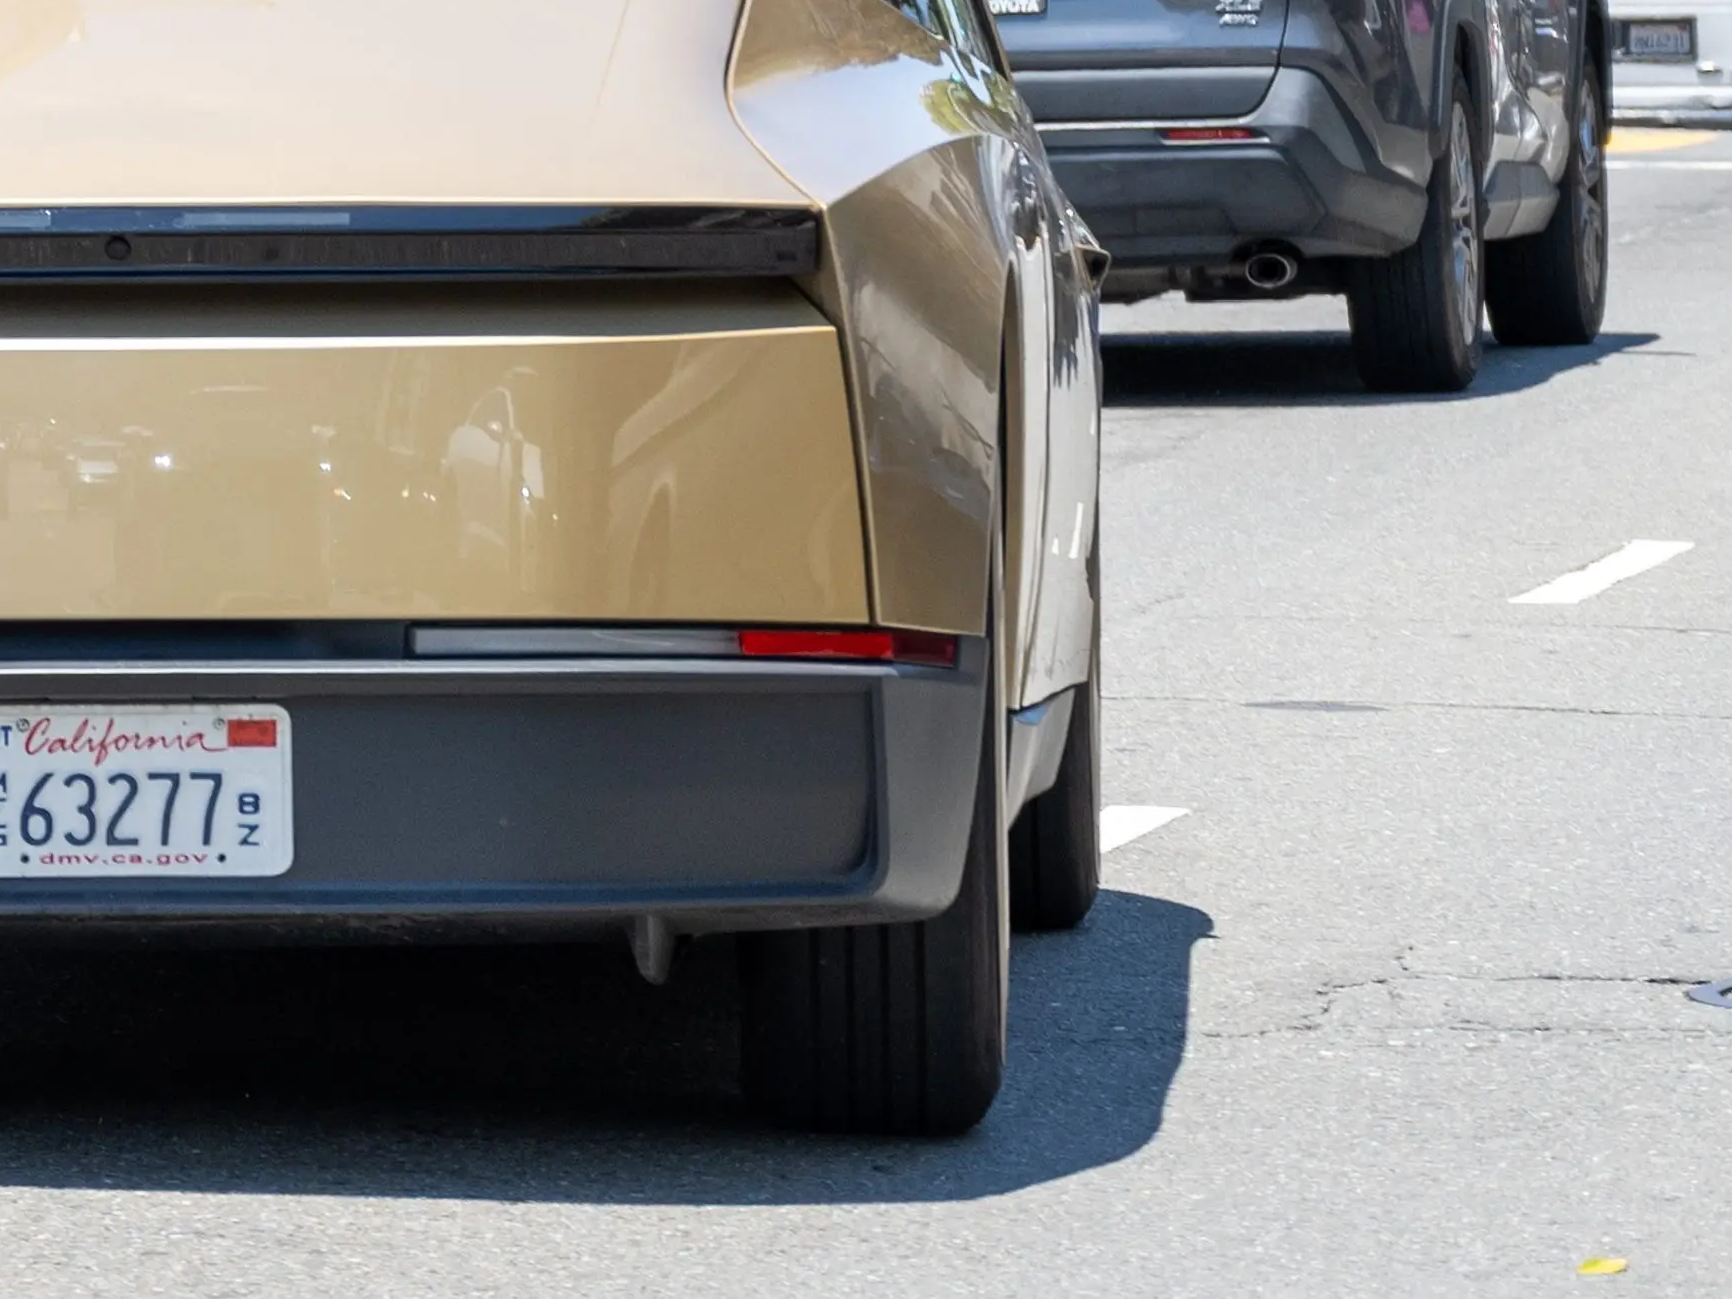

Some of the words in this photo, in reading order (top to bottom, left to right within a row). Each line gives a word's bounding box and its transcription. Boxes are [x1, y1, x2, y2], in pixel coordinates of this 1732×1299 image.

[988, 0, 1040, 14] OYOTA
[24, 717, 229, 766] California
[20, 771, 223, 846] 63277
[39, 852, 208, 866] dmv.ca.gov
